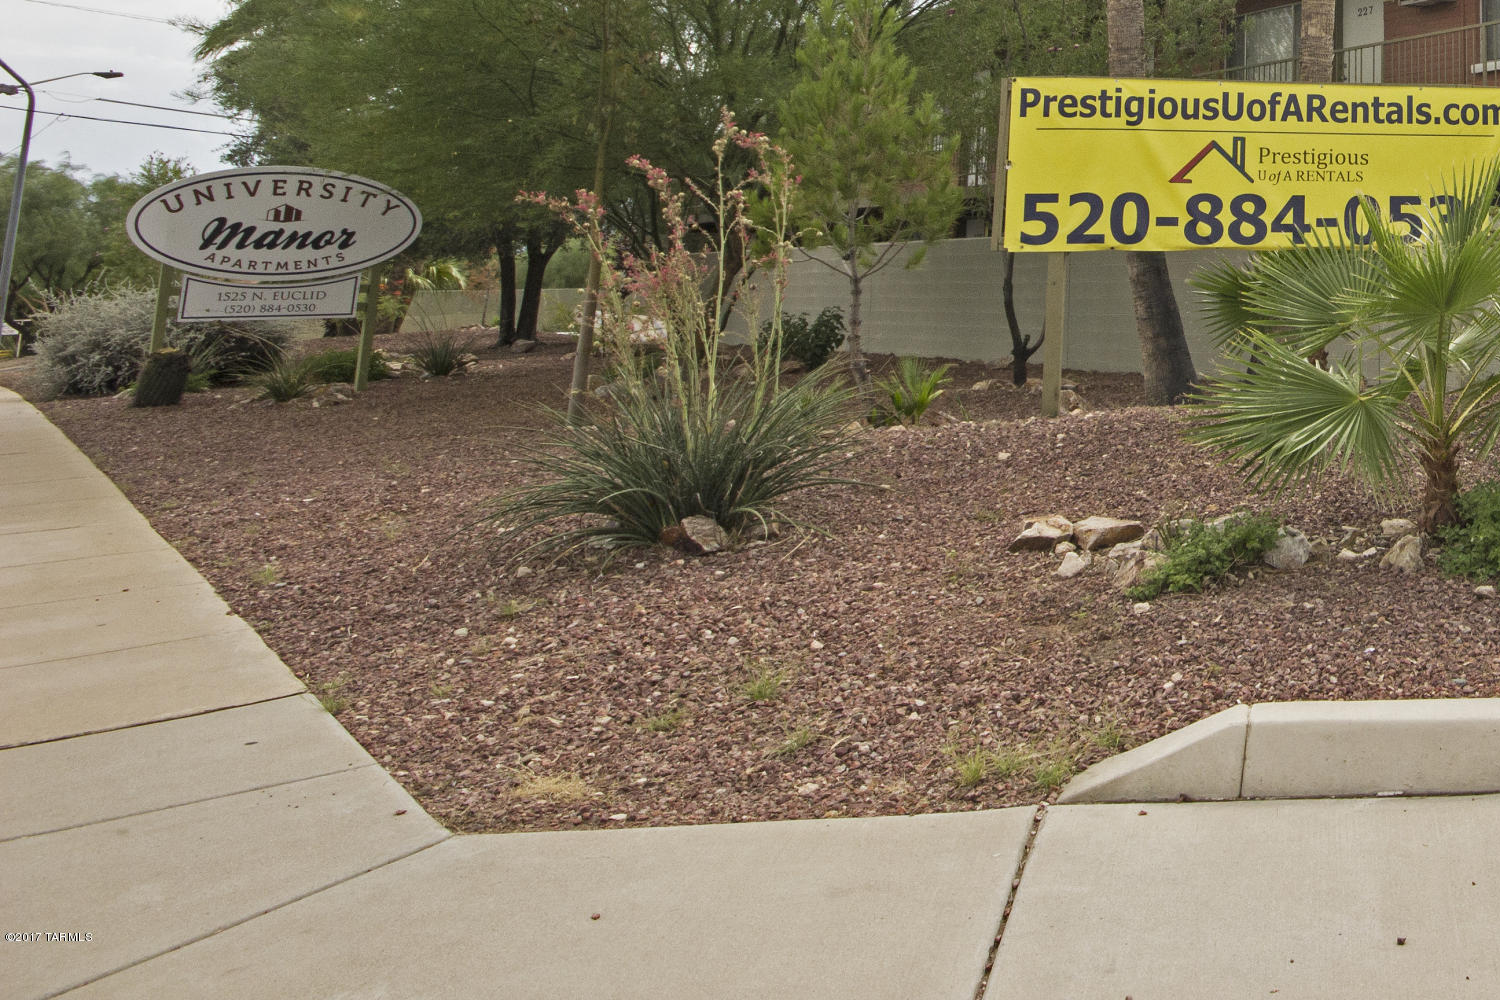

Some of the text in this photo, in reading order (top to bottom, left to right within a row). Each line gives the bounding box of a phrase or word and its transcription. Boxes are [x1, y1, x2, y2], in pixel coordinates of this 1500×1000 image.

[1357, 6, 1373, 17] 227
[1258, 146, 1369, 169] Prestigious
[1296, 170, 1364, 182] RENTALS
[160, 178, 401, 217] UNIVERSITY
[199, 216, 357, 251] Manor
[204, 252, 346, 272] APARTMENTS
[217, 290, 327, 302] 1525 N. EUCLID
[224, 303, 316, 314] (520) 884-0530
